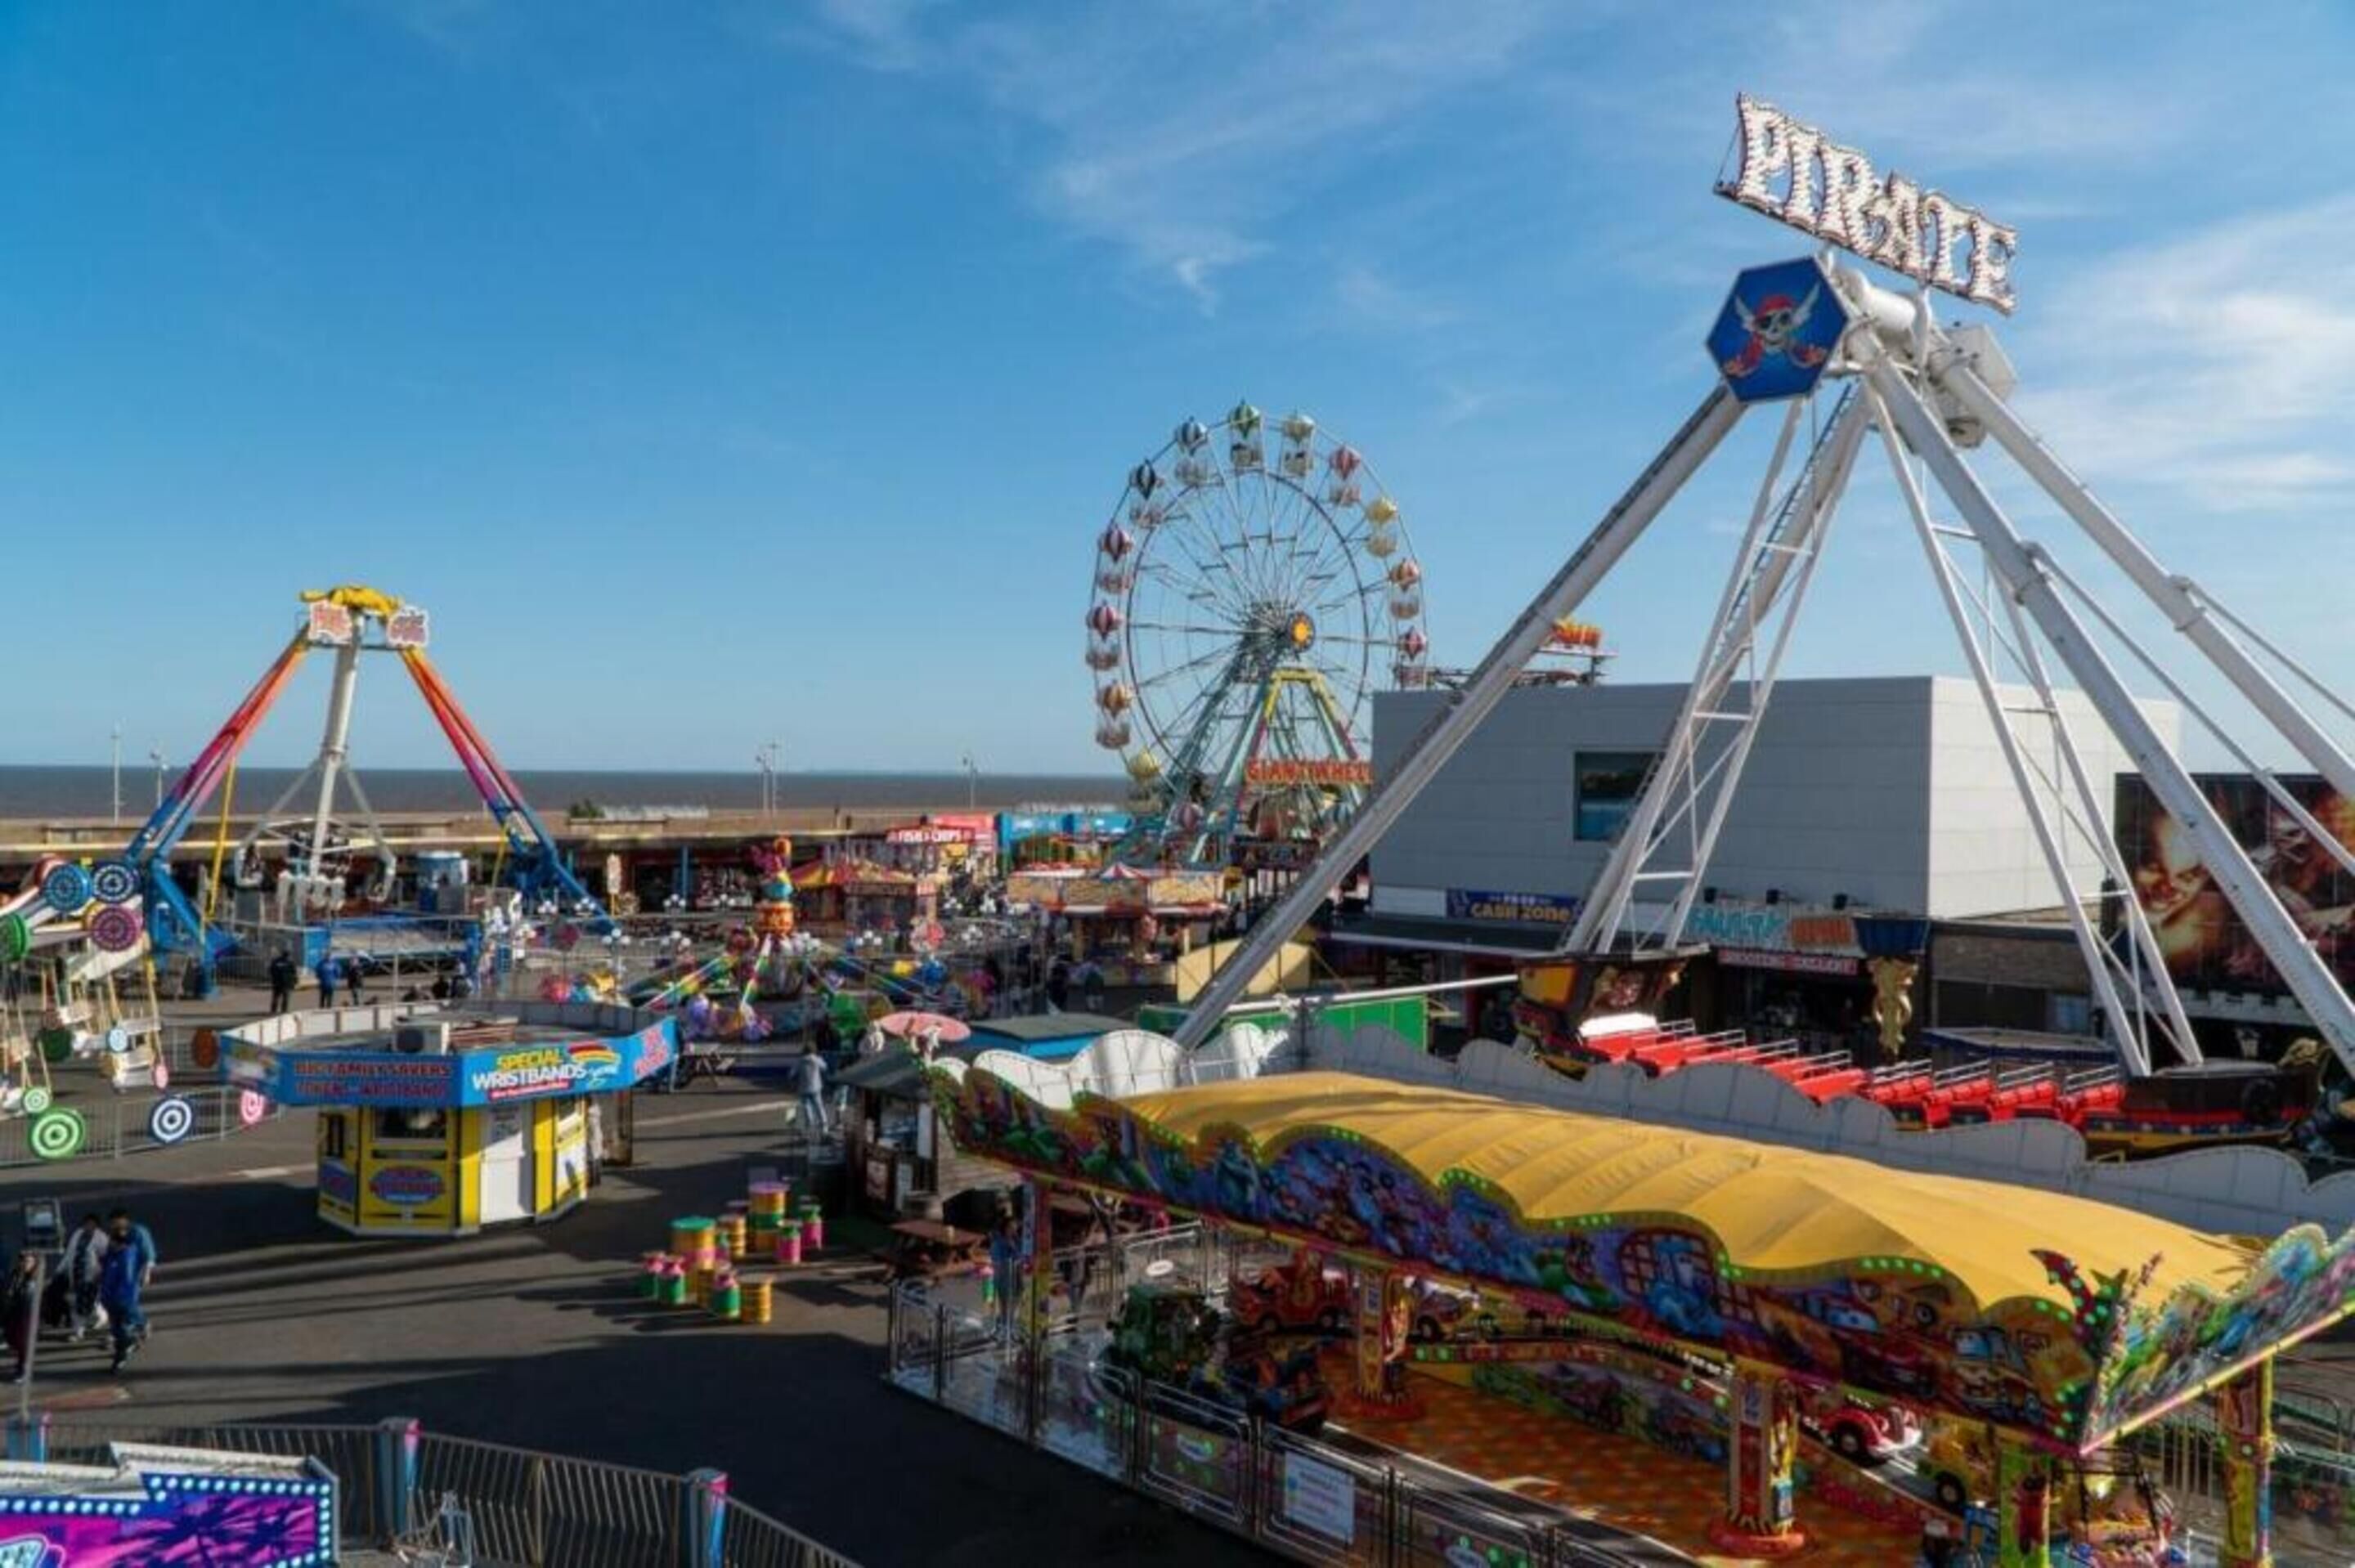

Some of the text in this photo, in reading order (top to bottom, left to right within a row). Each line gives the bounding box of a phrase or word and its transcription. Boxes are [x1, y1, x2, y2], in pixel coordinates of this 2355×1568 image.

[1736, 92, 2018, 317] PIRATE
[496, 1047, 564, 1071] SPECIAL
[472, 1061, 587, 1091] WRISTBANDS
